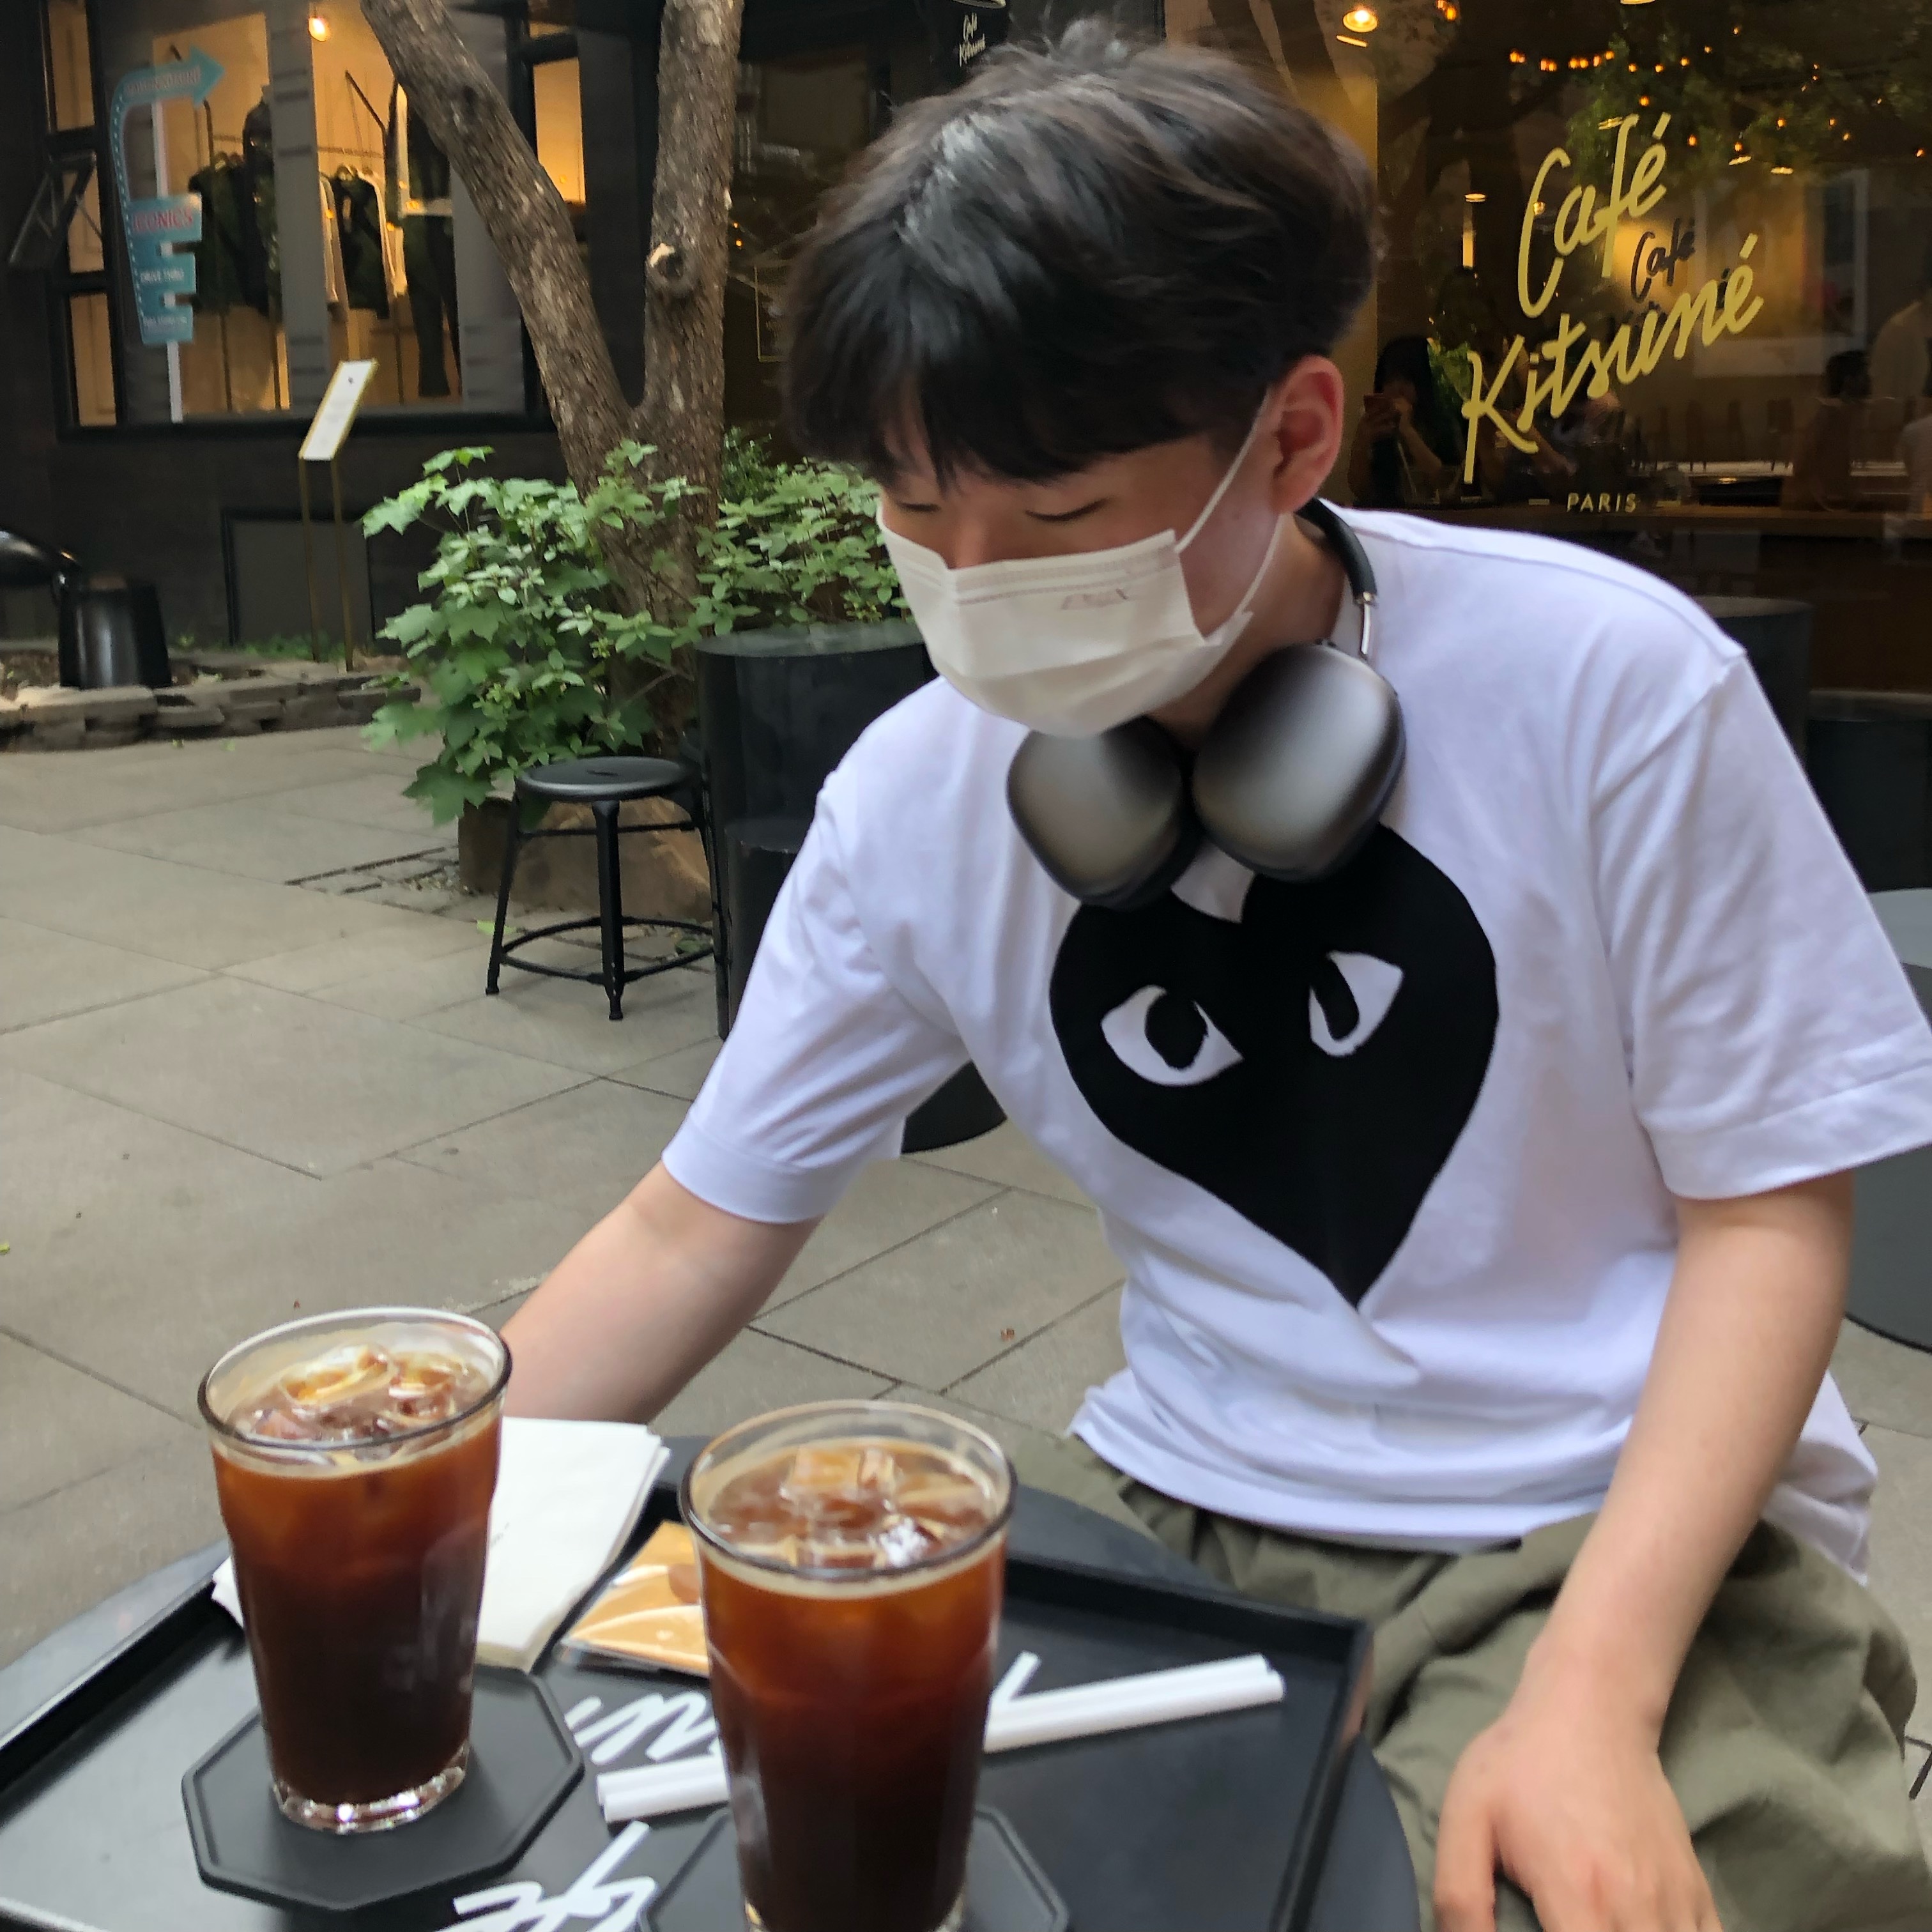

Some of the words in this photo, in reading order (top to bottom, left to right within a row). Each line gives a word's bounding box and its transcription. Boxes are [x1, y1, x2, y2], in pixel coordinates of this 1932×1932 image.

[1518, 112, 1671, 318] Café
[1461, 233, 1765, 484] Kitsuné
[1567, 492, 1637, 513] PARIS
